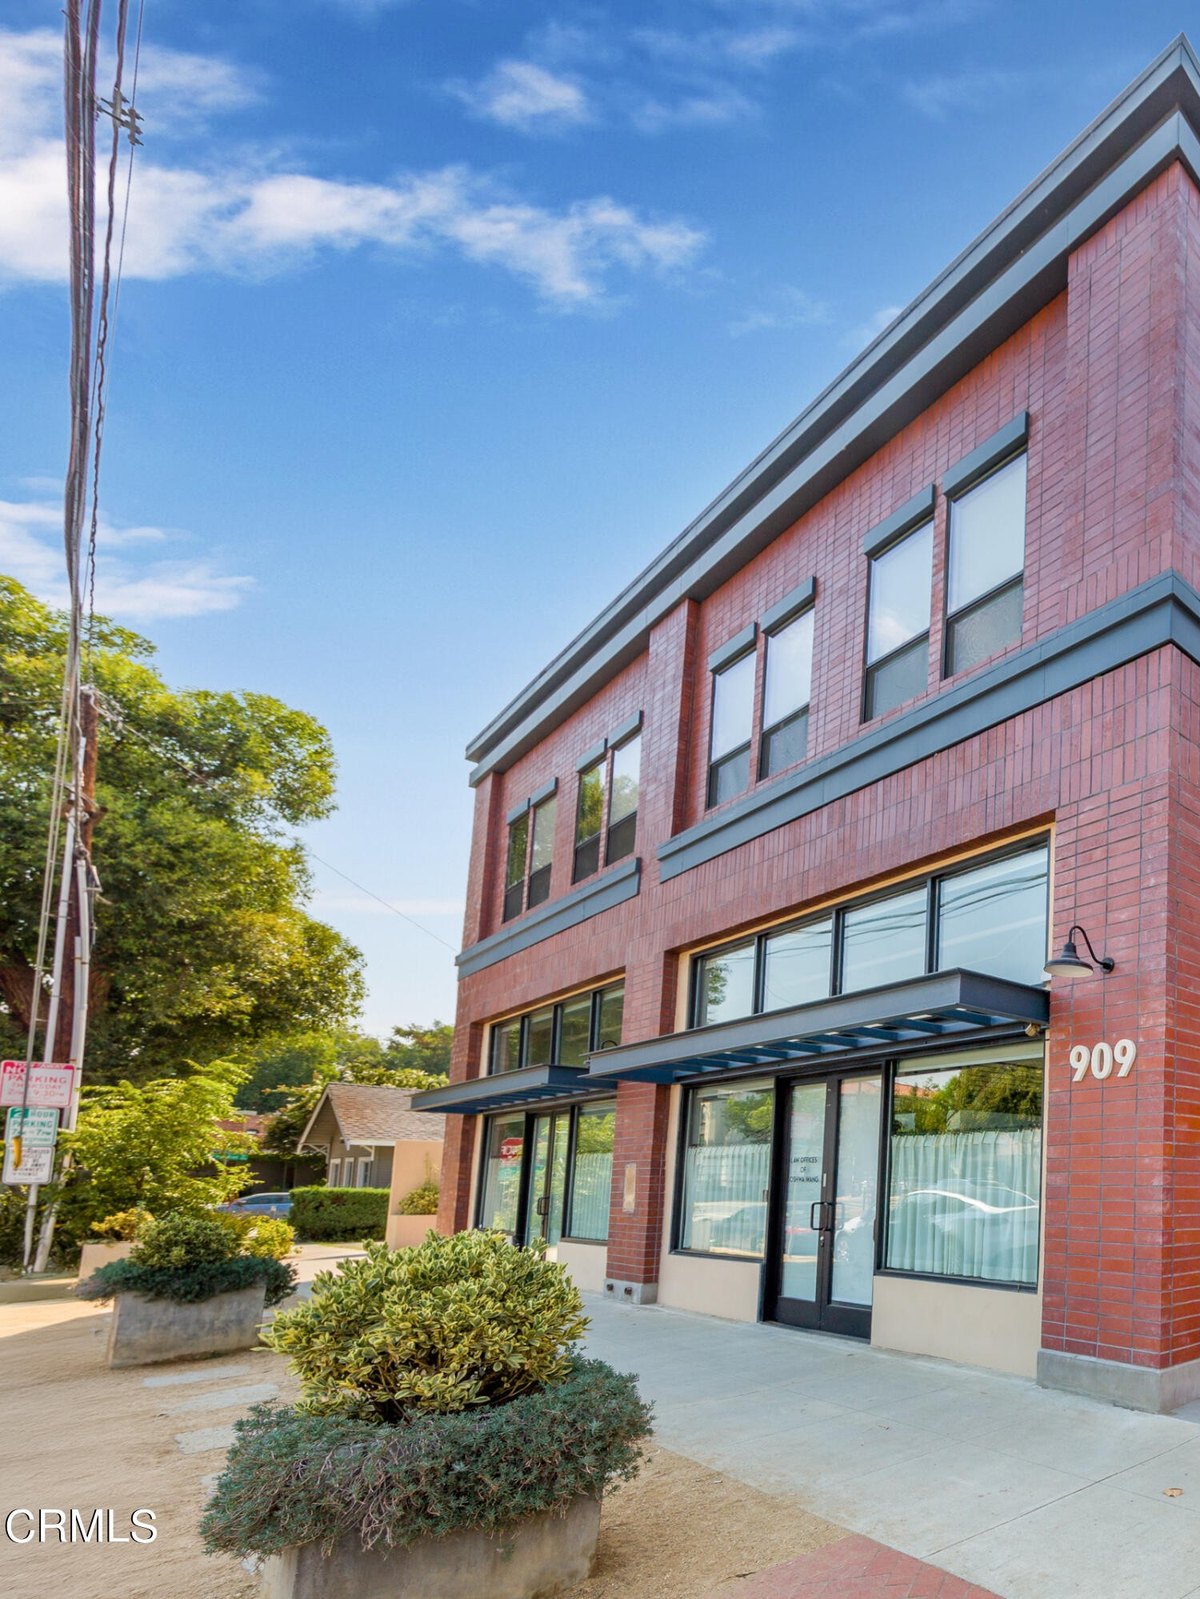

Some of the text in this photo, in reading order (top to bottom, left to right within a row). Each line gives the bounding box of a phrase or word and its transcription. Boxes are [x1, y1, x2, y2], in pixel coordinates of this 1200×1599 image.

[1069, 1038, 1137, 1082] 909
[6, 1066, 26, 1074] NO
[8, 1074, 67, 1084] PARKING
[12, 1082, 62, 1090] THRSDAY
[30, 1109, 55, 1118] HOUR
[12, 1119, 53, 1128] PARKING
[800, 1156, 818, 1164] OFFICES
